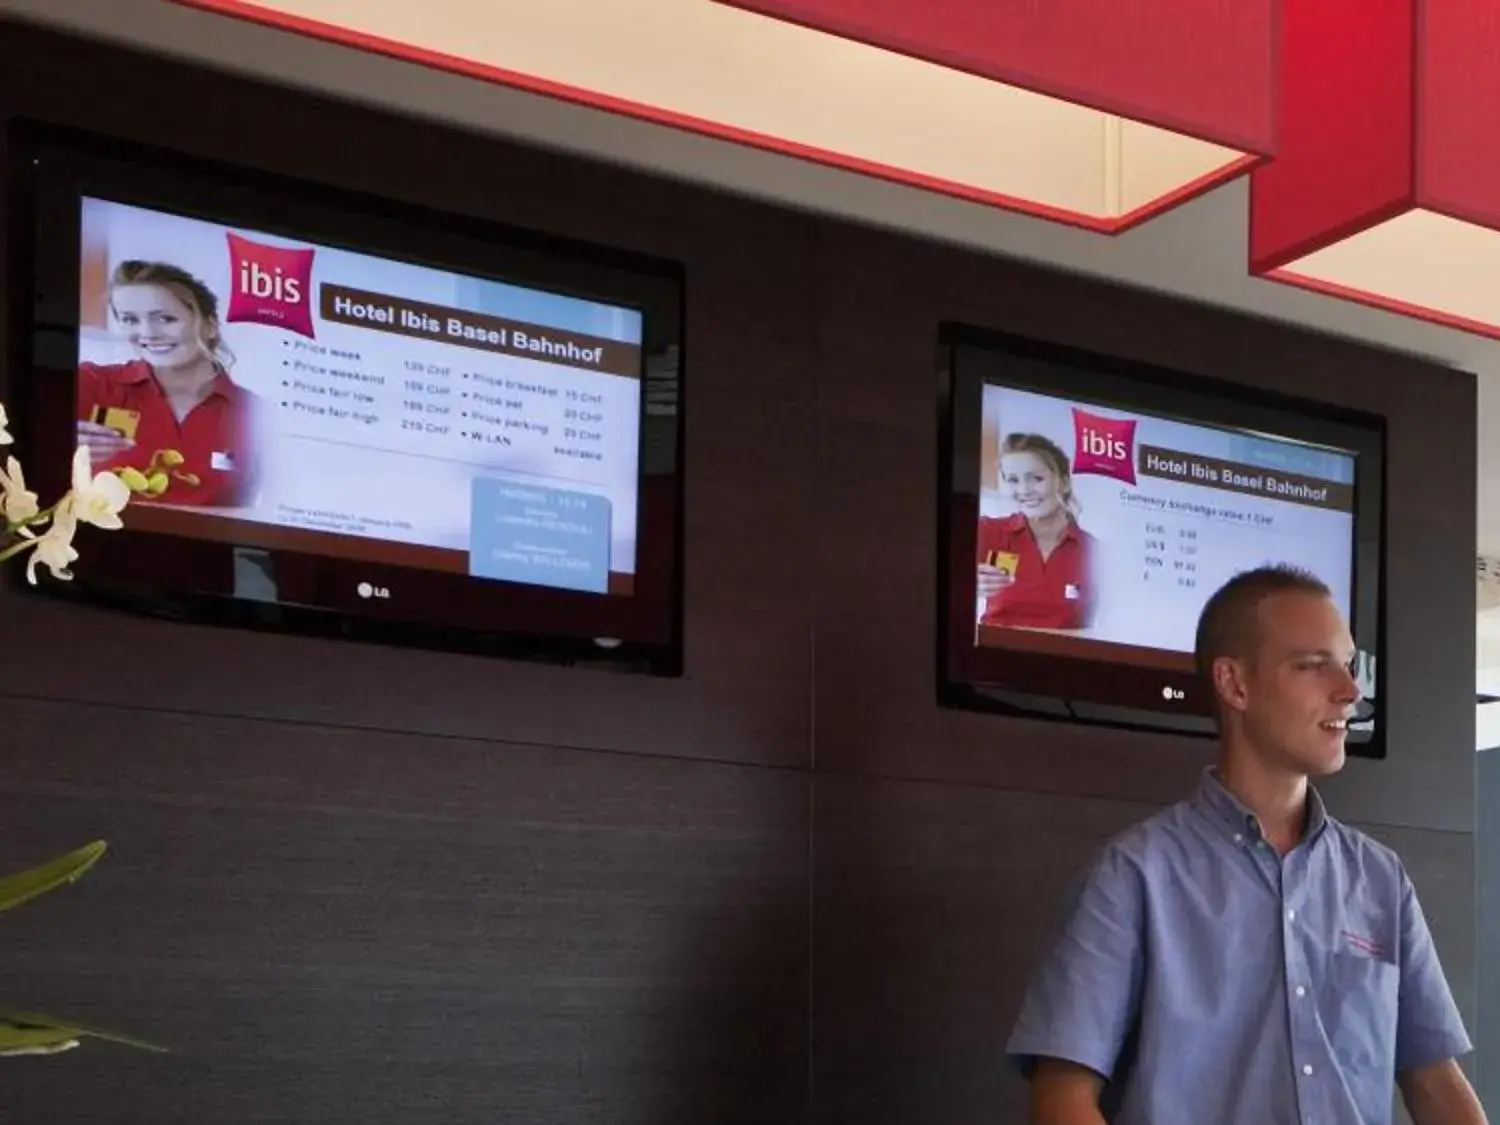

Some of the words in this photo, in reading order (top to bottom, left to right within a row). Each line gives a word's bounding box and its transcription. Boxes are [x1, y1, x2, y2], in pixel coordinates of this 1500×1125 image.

[240, 260, 301, 303] ibis
[294, 340, 327, 355] Price
[335, 296, 394, 325] Hotel
[400, 308, 440, 333] Ibis
[447, 318, 506, 346] Basel
[513, 331, 604, 363] Bahnhof
[294, 360, 327, 375] Price
[1082, 428, 1127, 460] ibis
[1147, 454, 1187, 475] Hotel
[1191, 460, 1218, 481] Ibis
[1222, 468, 1263, 489] Basel
[1266, 475, 1328, 501] Bahnhof
